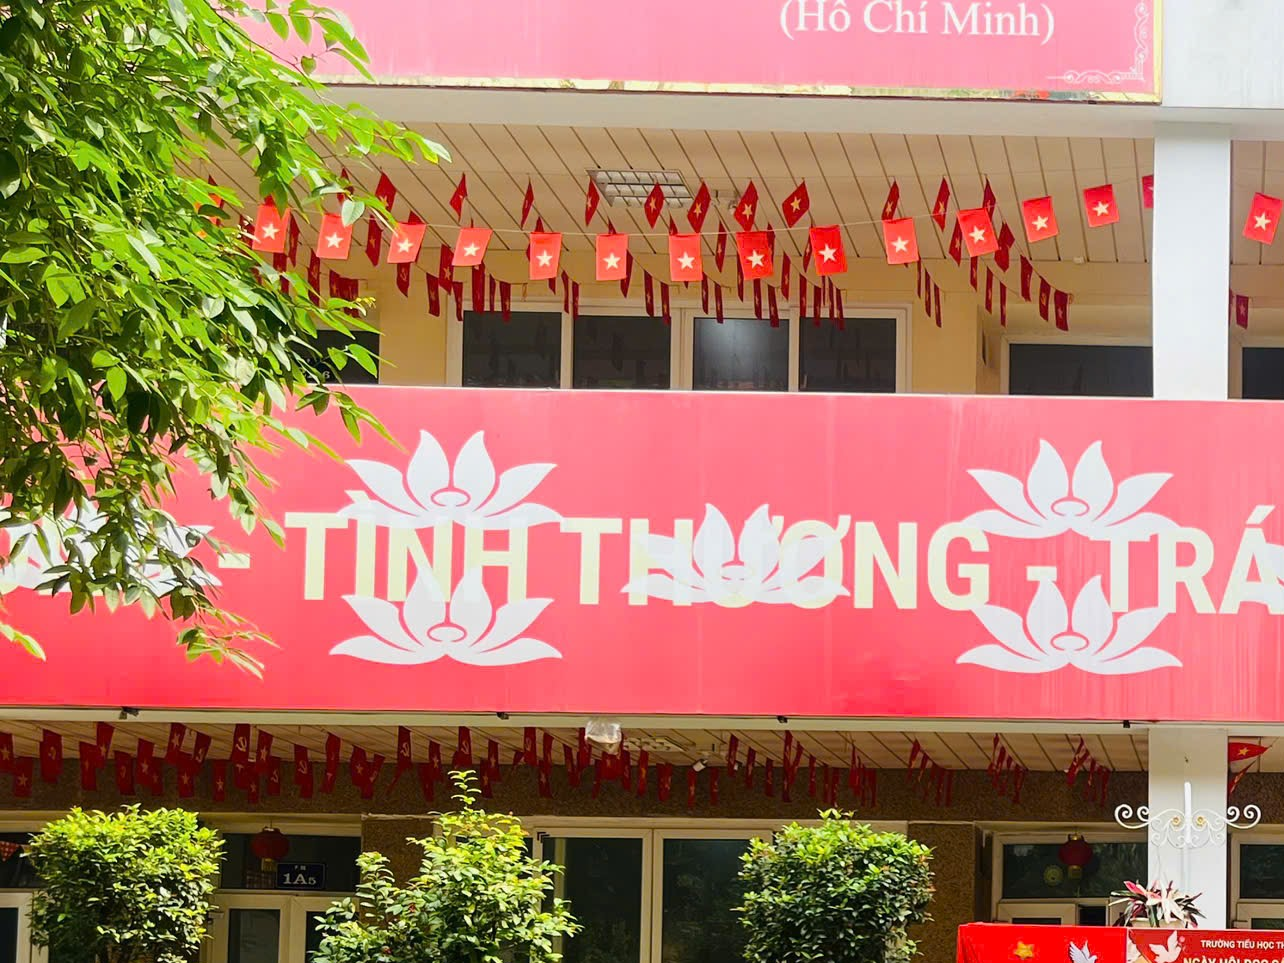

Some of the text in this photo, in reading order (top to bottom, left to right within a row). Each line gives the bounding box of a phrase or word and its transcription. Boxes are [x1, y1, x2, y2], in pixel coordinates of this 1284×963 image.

[941, 1, 1055, 45] Minh)
[285, 490, 529, 602] TÌNH
[560, 515, 990, 610] THƠNG
[1201, 939, 1235, 949] TRƯỜNG
[1257, 941, 1274, 950] HỌC
